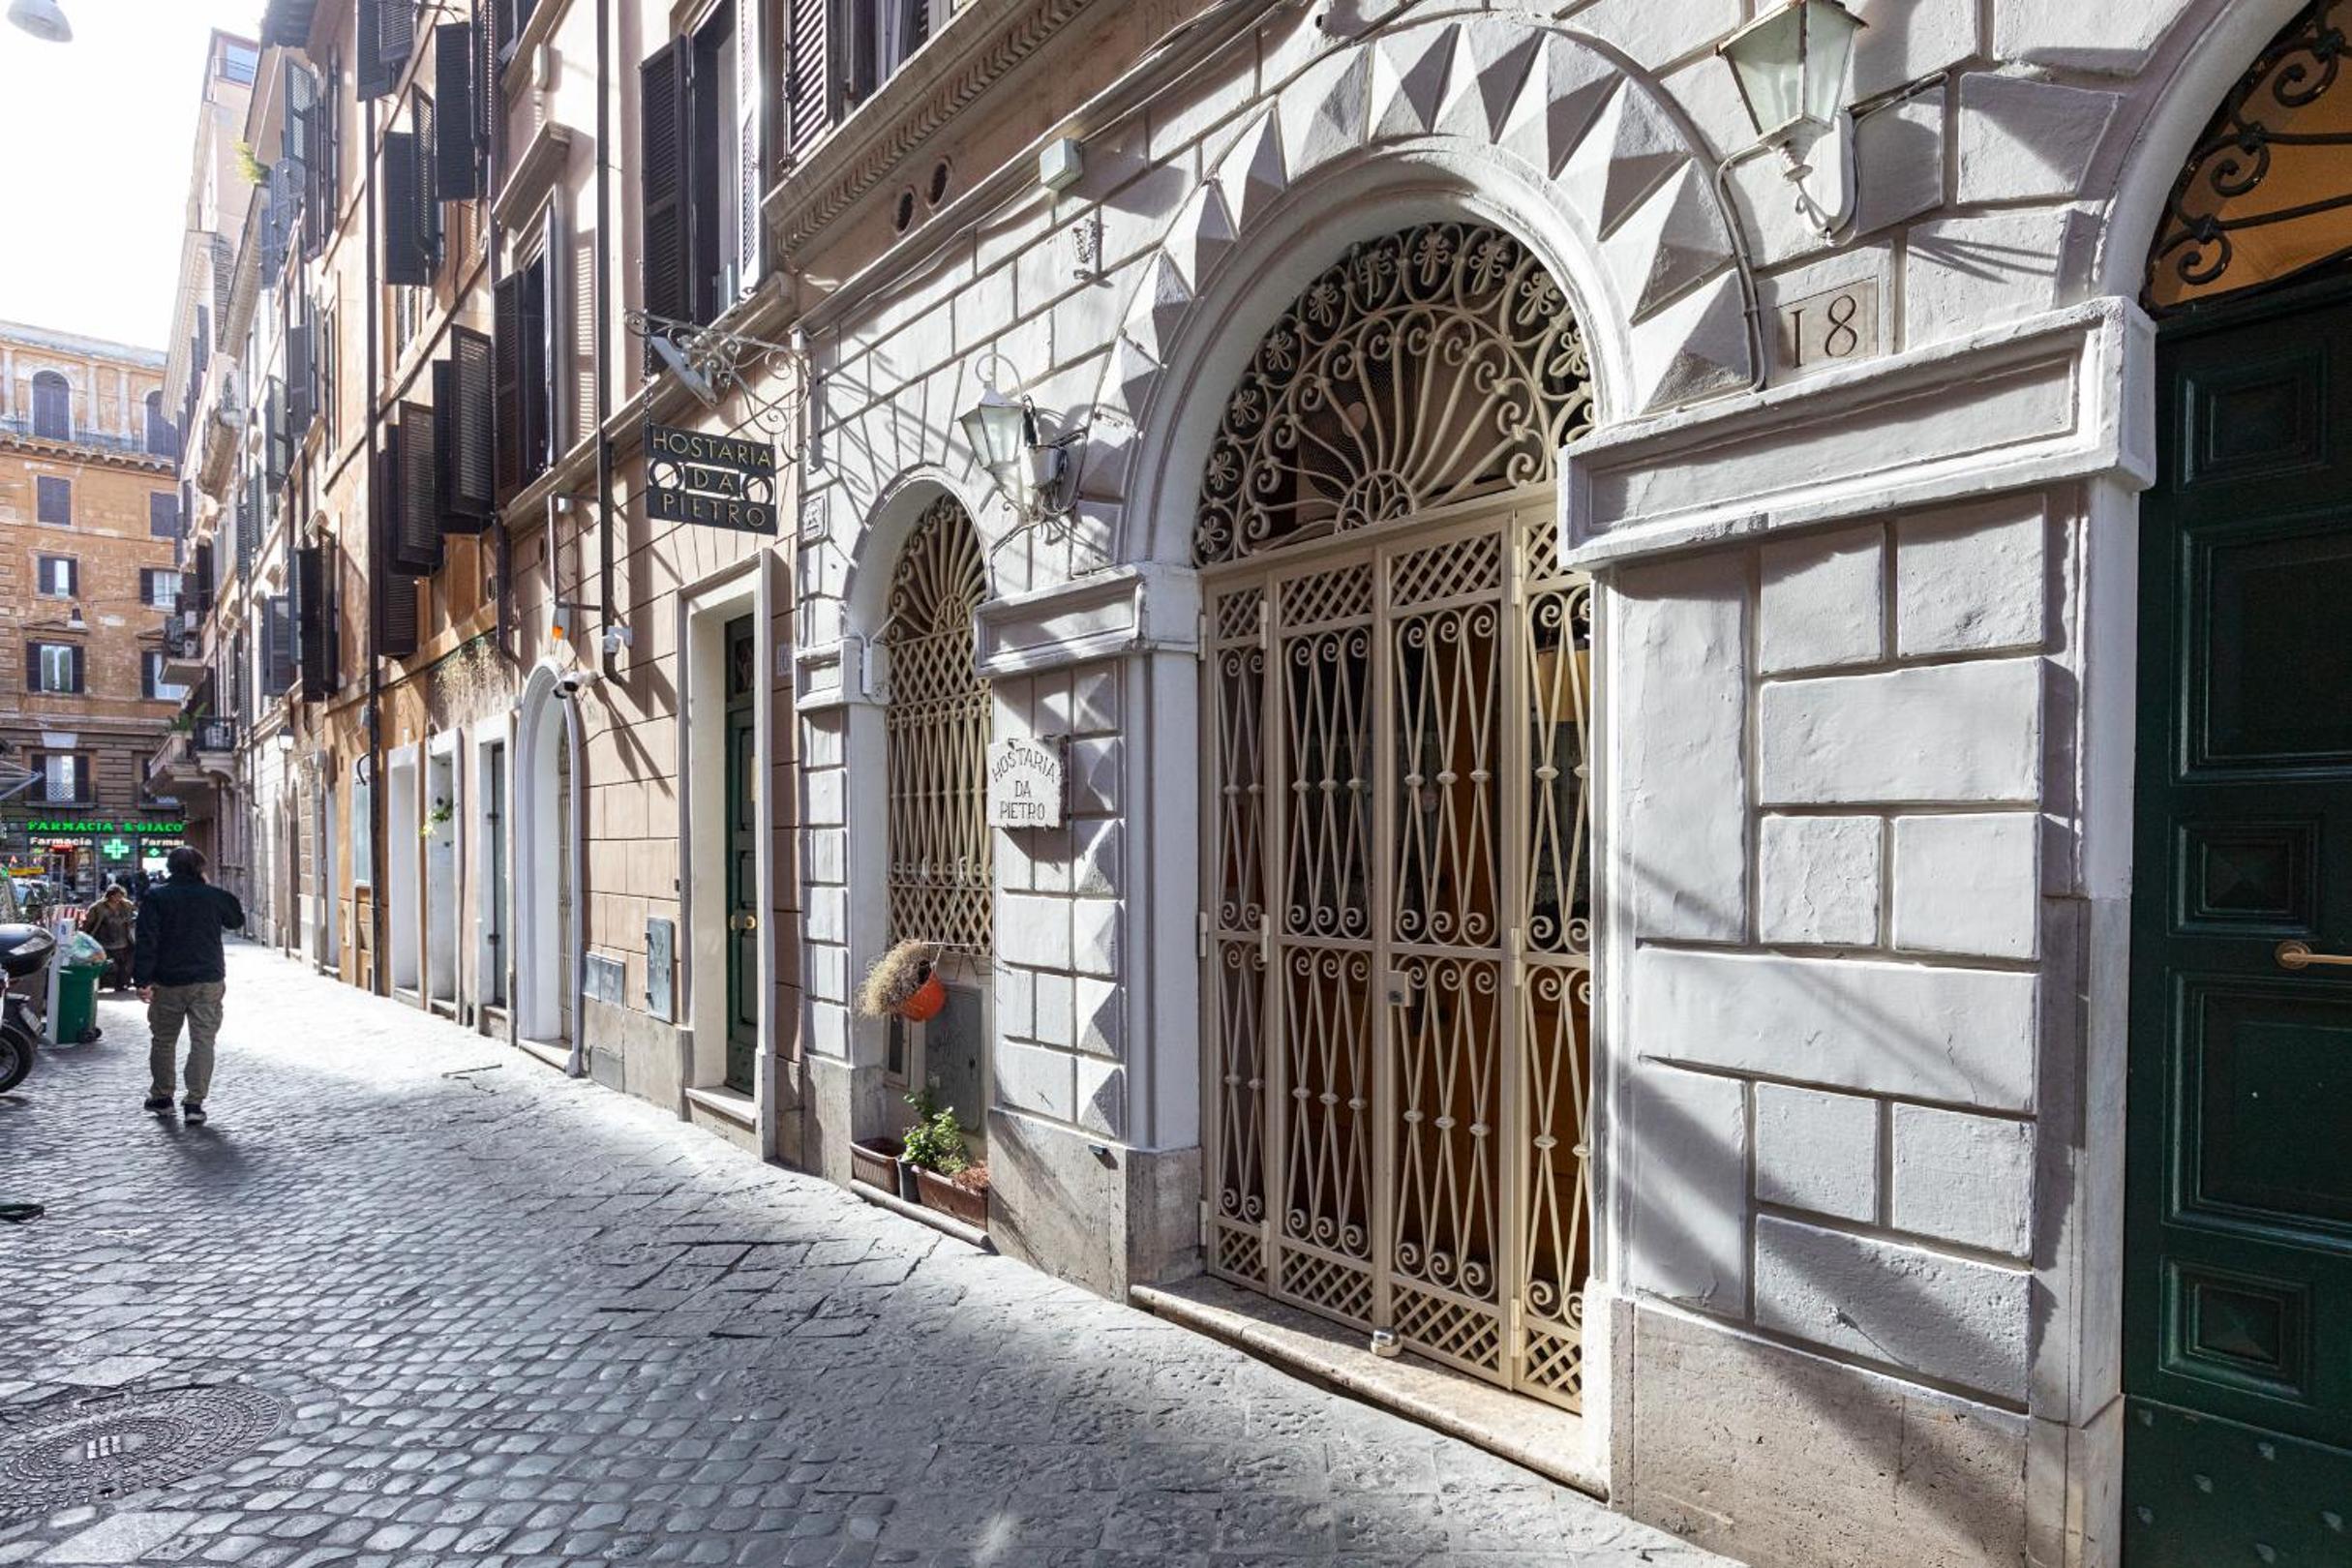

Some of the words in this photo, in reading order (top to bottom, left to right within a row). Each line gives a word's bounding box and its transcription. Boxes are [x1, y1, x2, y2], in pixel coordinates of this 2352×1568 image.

[1790, 293, 1858, 368] 18
[651, 430, 771, 467] HOSTARIA
[693, 468, 734, 492] DA
[662, 494, 766, 527] PIETRO
[992, 747, 1055, 784] HOSTARIA
[1014, 780, 1032, 799] DA
[999, 800, 1045, 821] PIETRO
[27, 821, 113, 831] FARMACIA
[30, 836, 93, 846] Farmacia
